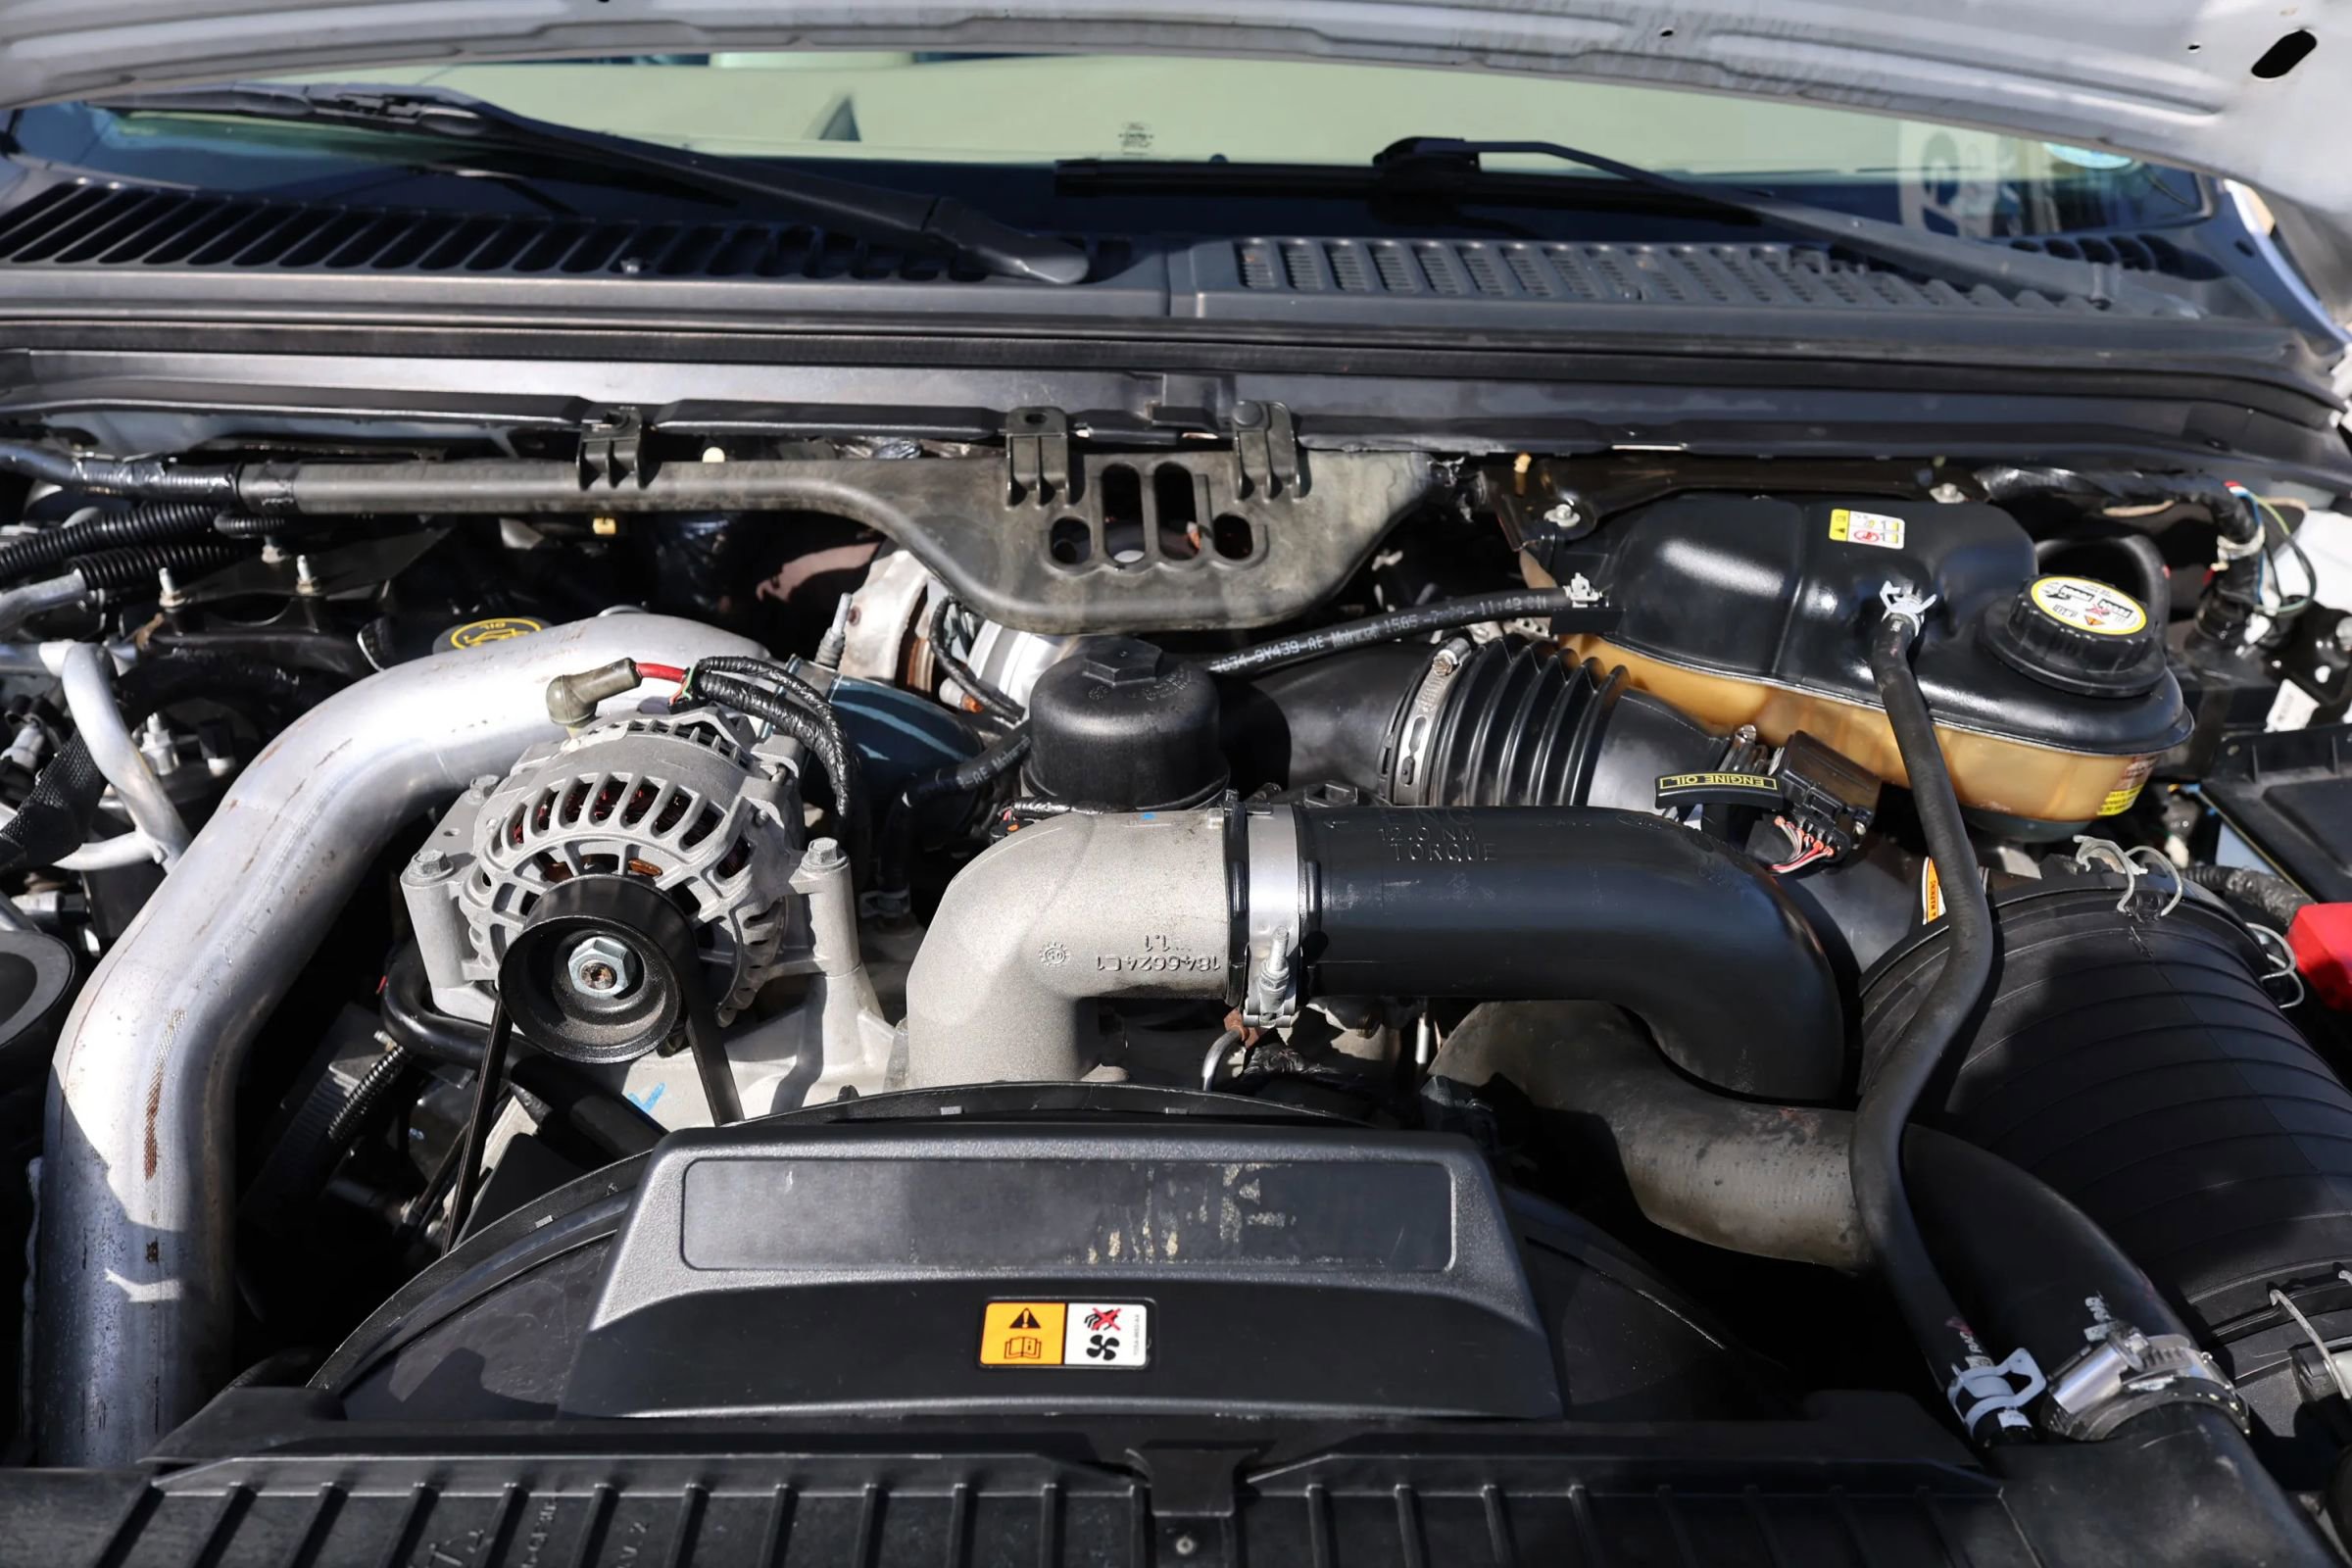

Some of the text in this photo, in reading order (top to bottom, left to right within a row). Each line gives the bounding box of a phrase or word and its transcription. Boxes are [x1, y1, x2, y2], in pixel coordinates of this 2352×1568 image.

[1670, 774, 1765, 787] ENGINE OIL
[1378, 826, 1431, 842] 12.0
[1390, 843, 1498, 863] TORQUE
[1097, 954, 1222, 972] 1846624C1
